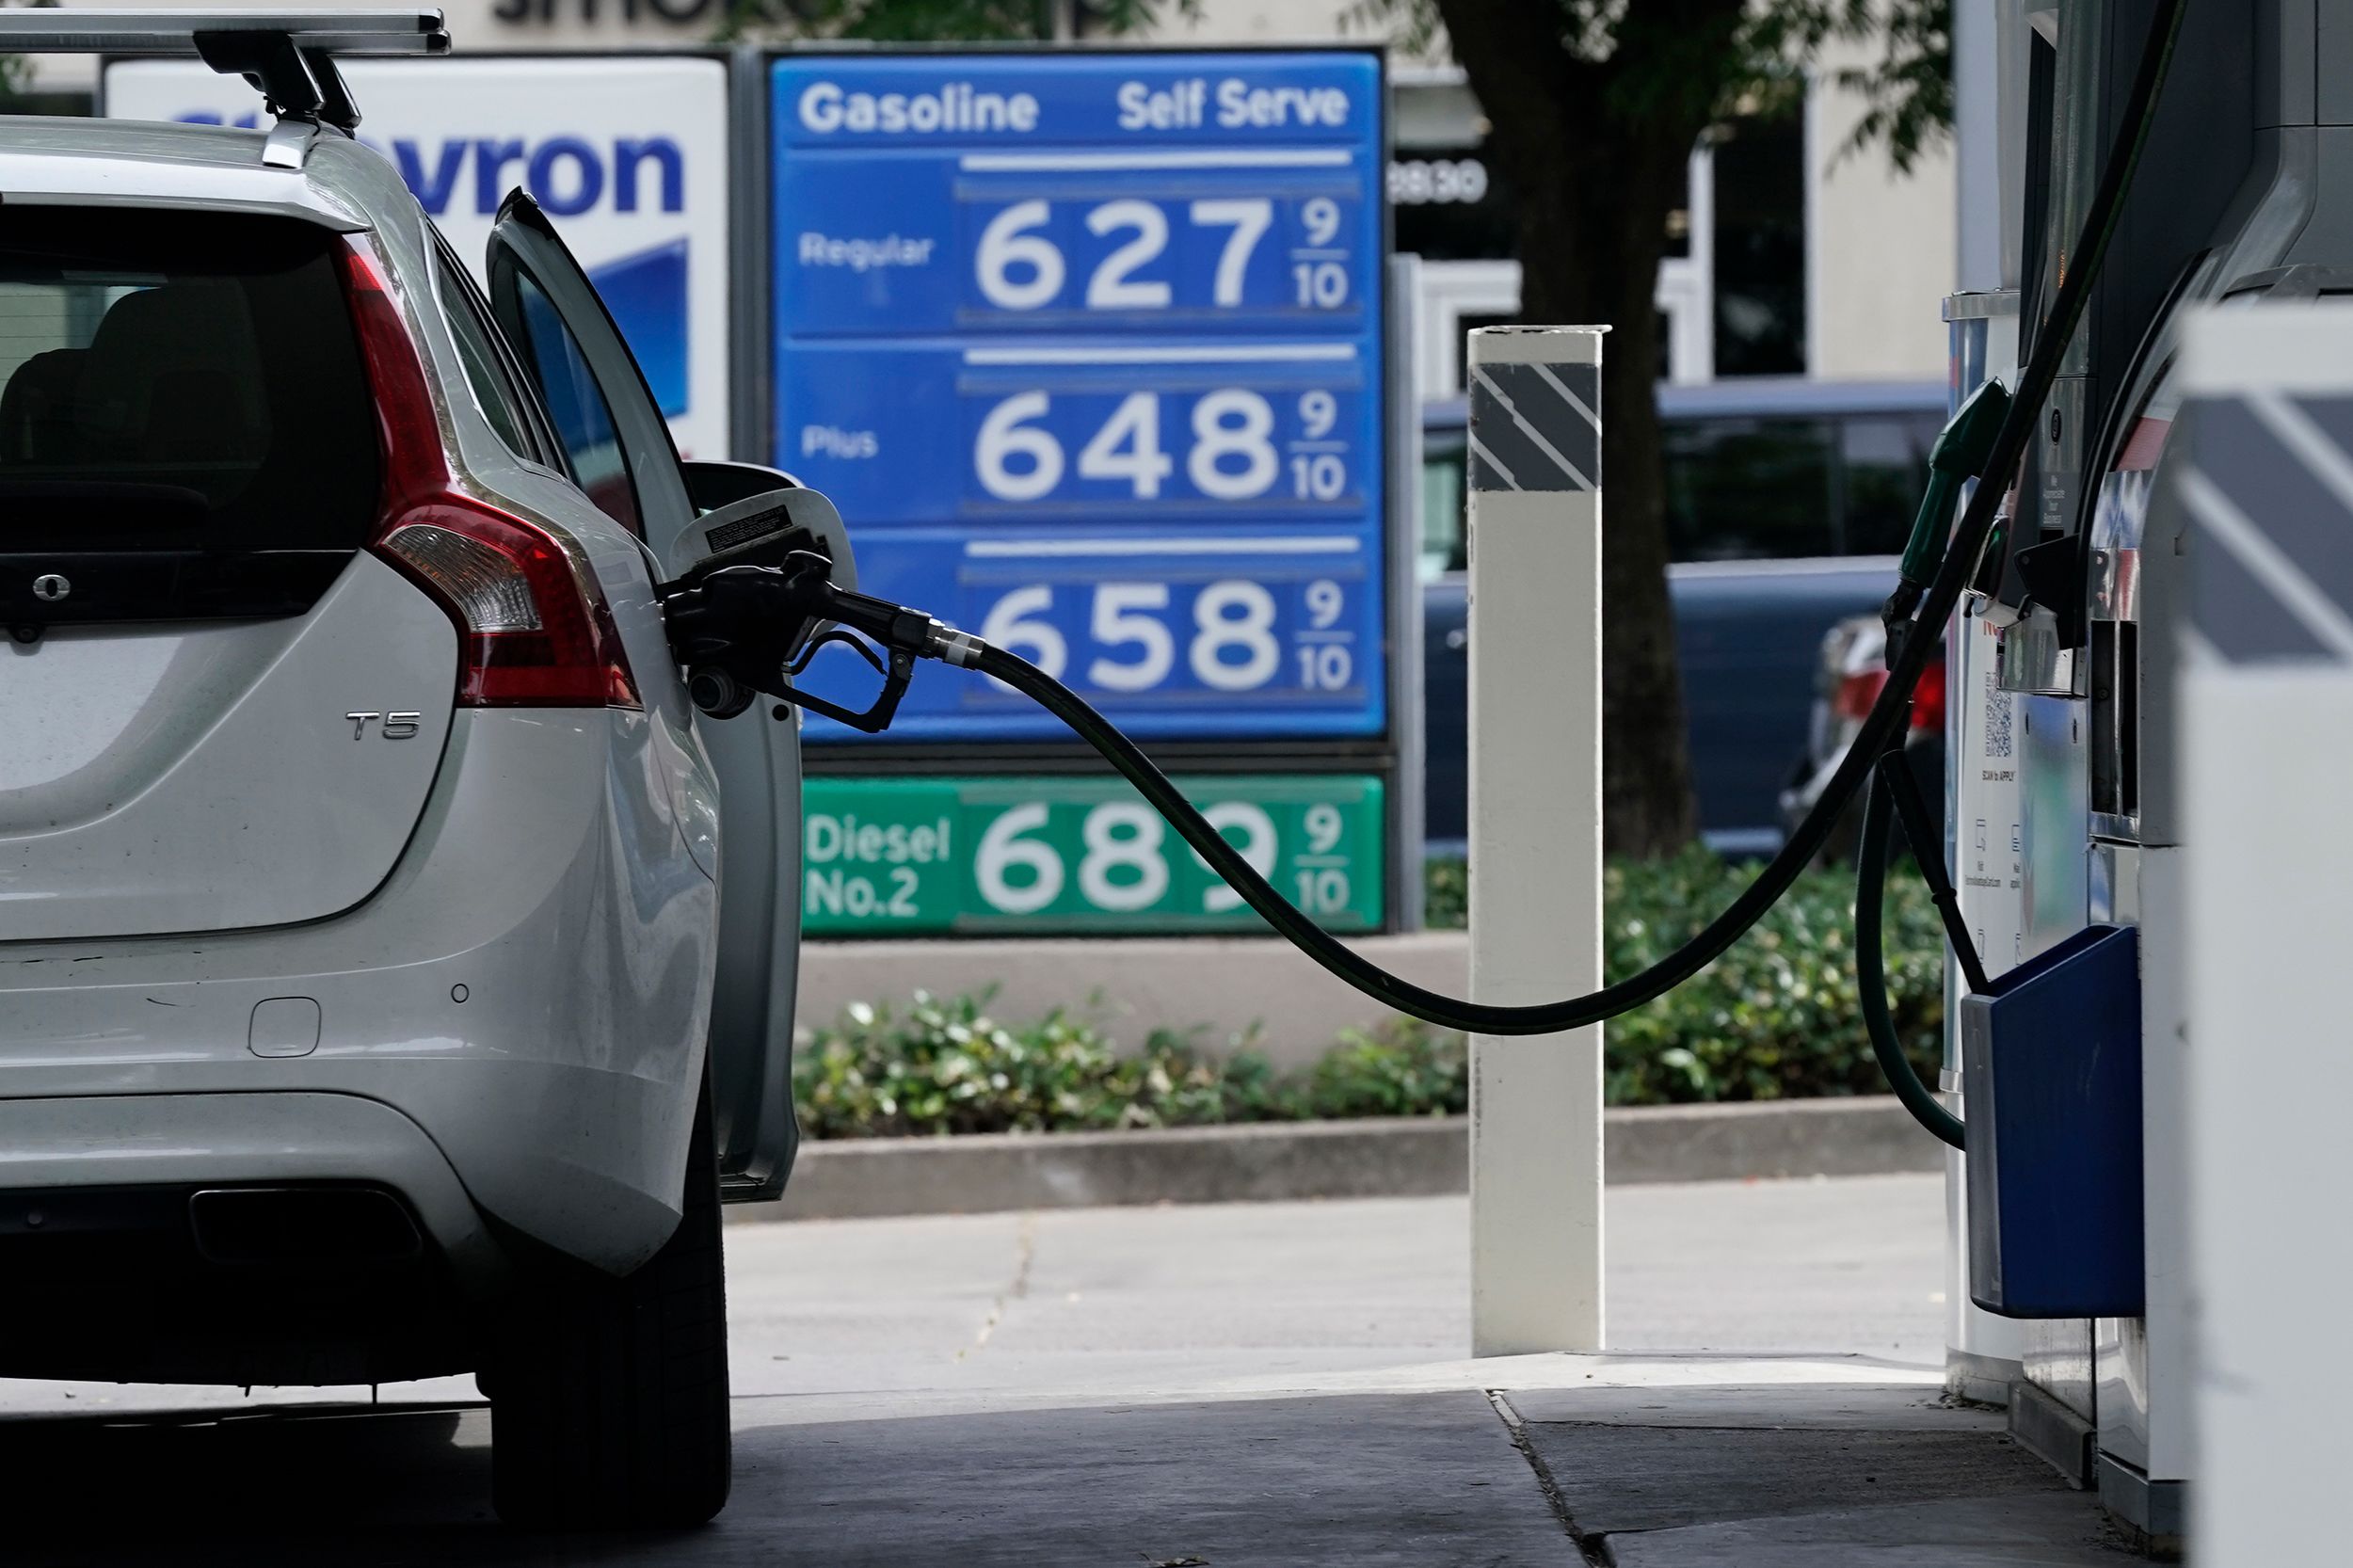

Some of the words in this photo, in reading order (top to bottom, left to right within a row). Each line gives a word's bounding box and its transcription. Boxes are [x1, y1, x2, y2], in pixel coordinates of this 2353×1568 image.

[799, 83, 1039, 132] Gasoline
[1117, 79, 1206, 129] Self
[1216, 78, 1350, 127] Serve
[797, 232, 933, 273] Regular
[975, 198, 1273, 311] 627
[801, 425, 879, 459] Plus
[975, 388, 1279, 502] 648
[980, 580, 1280, 695] 658
[345, 711, 421, 741] T5
[806, 813, 951, 864] Diesel
[806, 868, 920, 918] No.2
